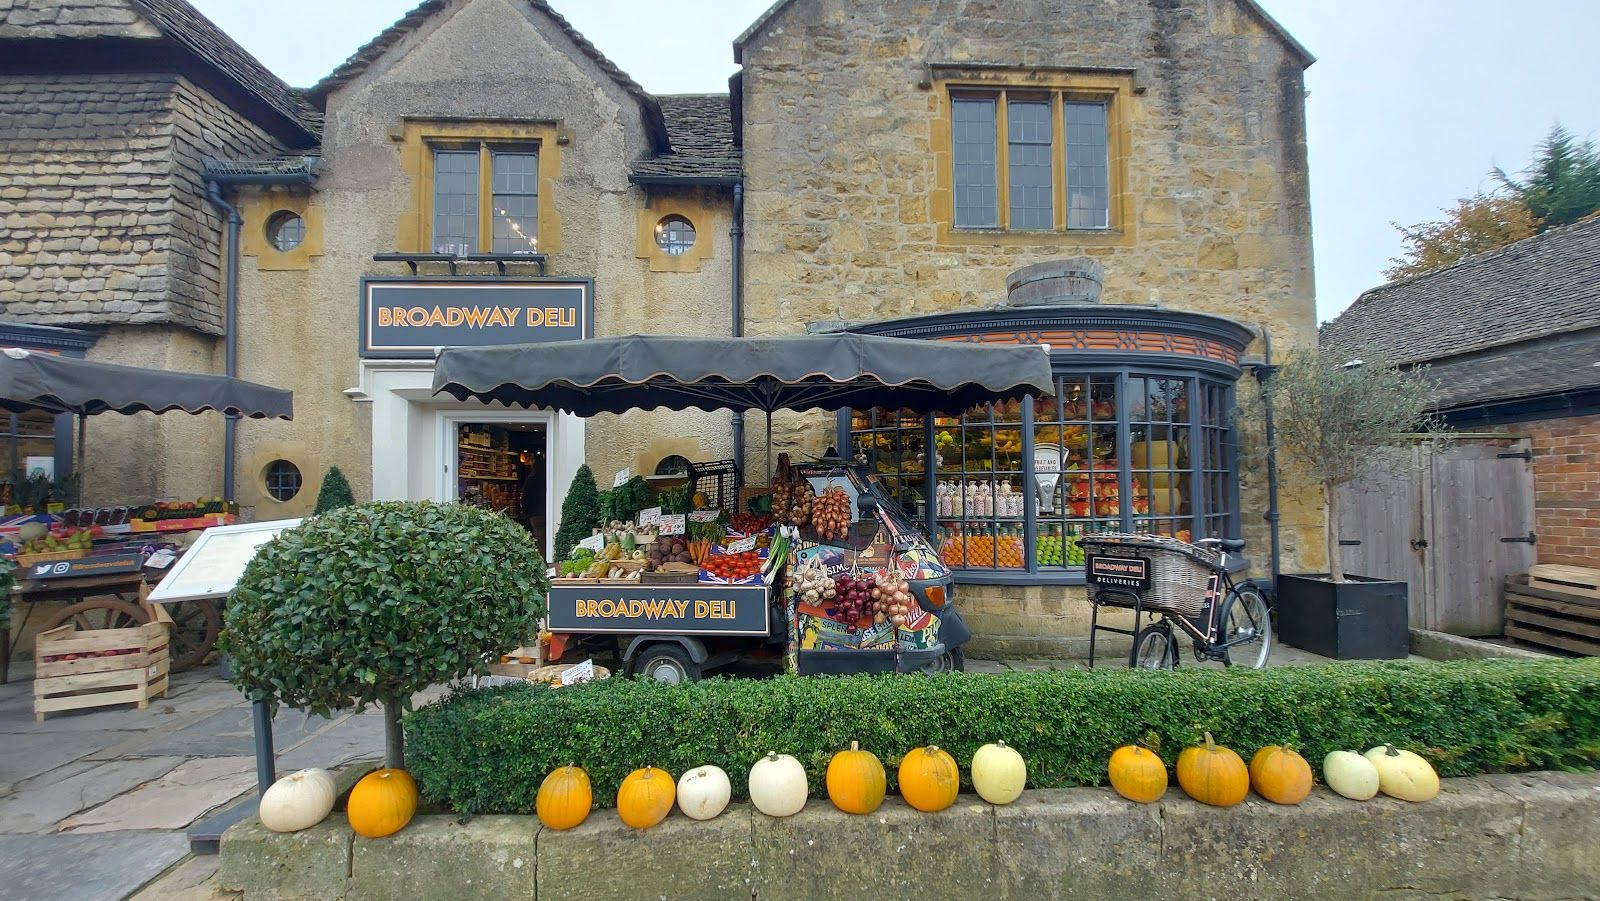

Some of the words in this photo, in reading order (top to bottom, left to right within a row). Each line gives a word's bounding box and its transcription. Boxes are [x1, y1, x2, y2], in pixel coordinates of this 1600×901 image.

[378, 305, 521, 329] BROADWAY
[527, 307, 576, 327] DELI
[1095, 562, 1128, 572] BROADWAY
[1097, 576, 1140, 587] DELIVERIES
[575, 598, 690, 620] BROADWAY
[694, 600, 736, 619] DELI
[821, 620, 861, 637] SPLEND
